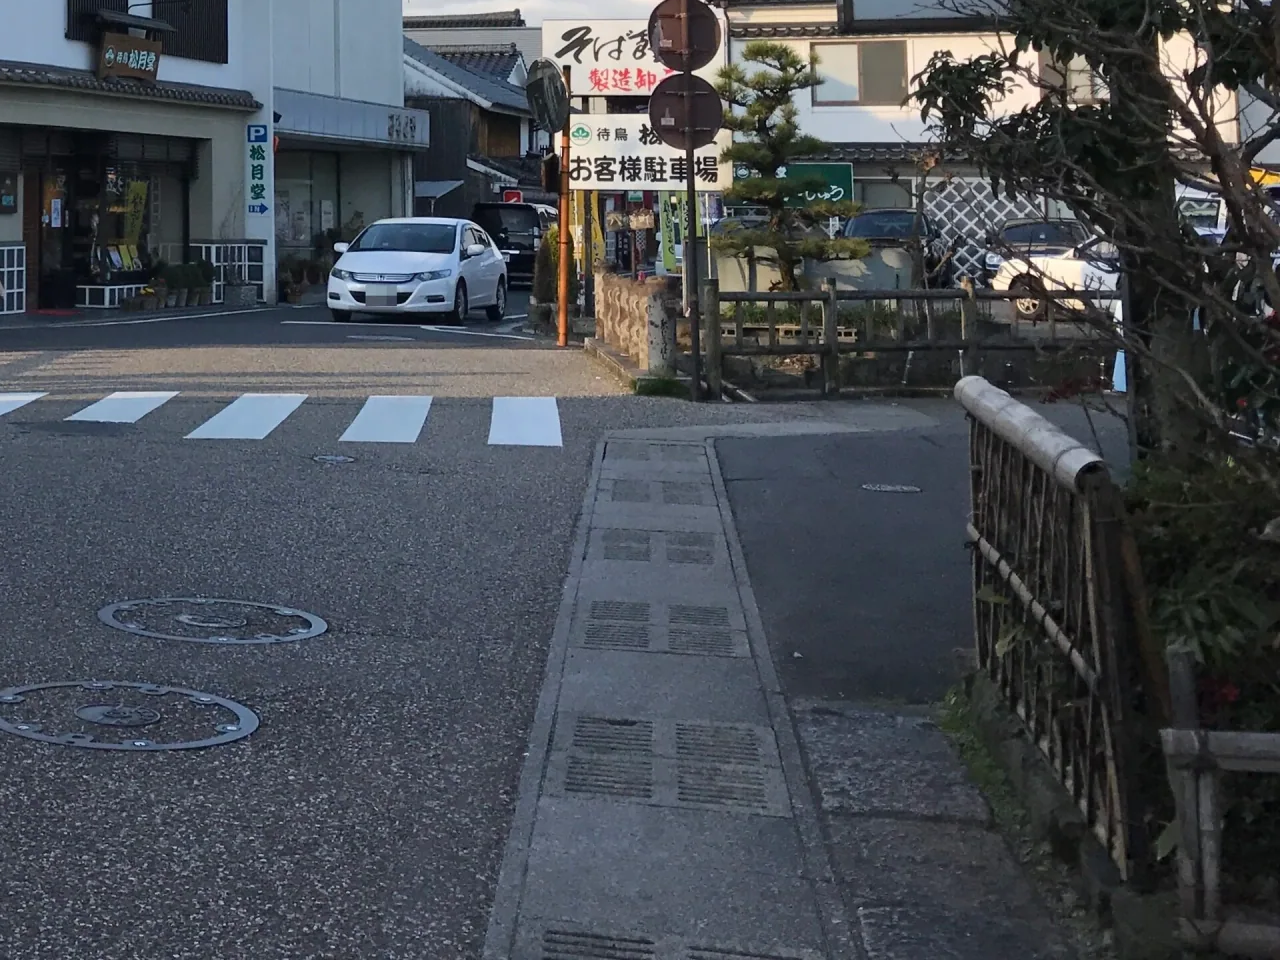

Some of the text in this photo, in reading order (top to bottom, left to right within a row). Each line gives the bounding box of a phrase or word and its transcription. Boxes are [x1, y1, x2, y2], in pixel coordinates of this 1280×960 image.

[589, 68, 675, 92] 製造卸
[250, 126, 265, 141] P
[596, 127, 628, 142] 待鳥
[249, 145, 266, 200] 松月堂
[570, 156, 718, 183] お客様駐車場
